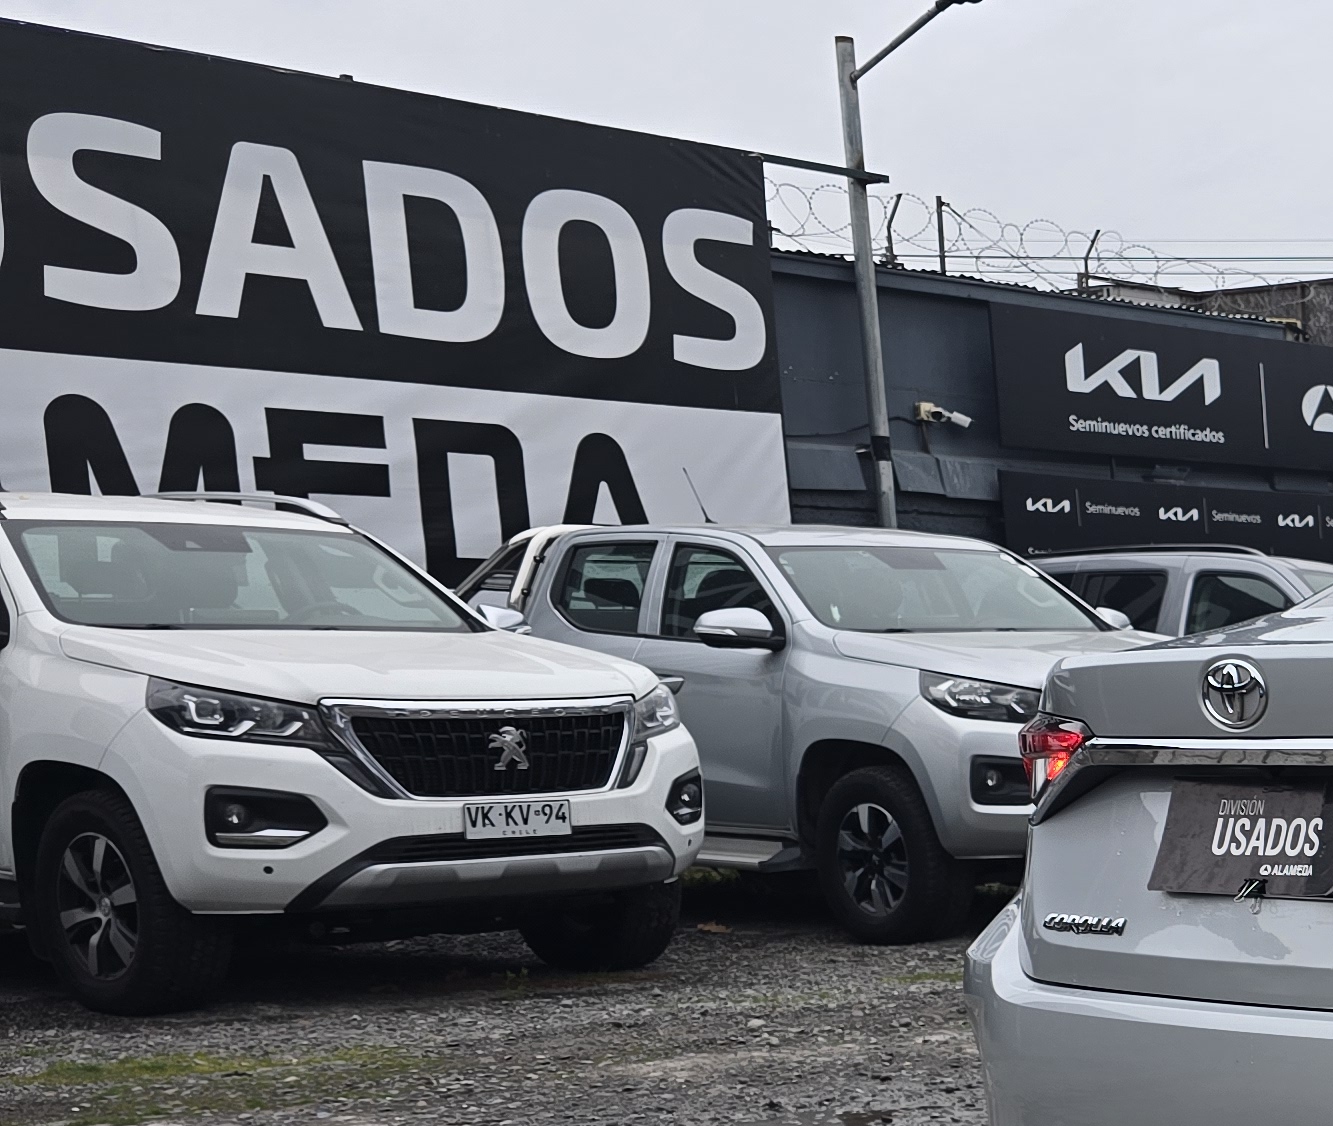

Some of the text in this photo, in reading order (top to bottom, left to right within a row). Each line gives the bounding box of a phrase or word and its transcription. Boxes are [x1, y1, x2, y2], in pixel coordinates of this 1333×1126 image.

[0, 112, 766, 371] SADOS
[1068, 414, 1225, 445] Seminuevos certificados
[1085, 501, 1141, 517] Seminuevos
[1211, 509, 1261, 524] Seminuevos
[1218, 795, 1266, 816] DIVISIÓN
[1211, 817, 1323, 857] USADOS
[1271, 864, 1313, 876] ALAMEDA
[1043, 912, 1127, 936] COROLLA
